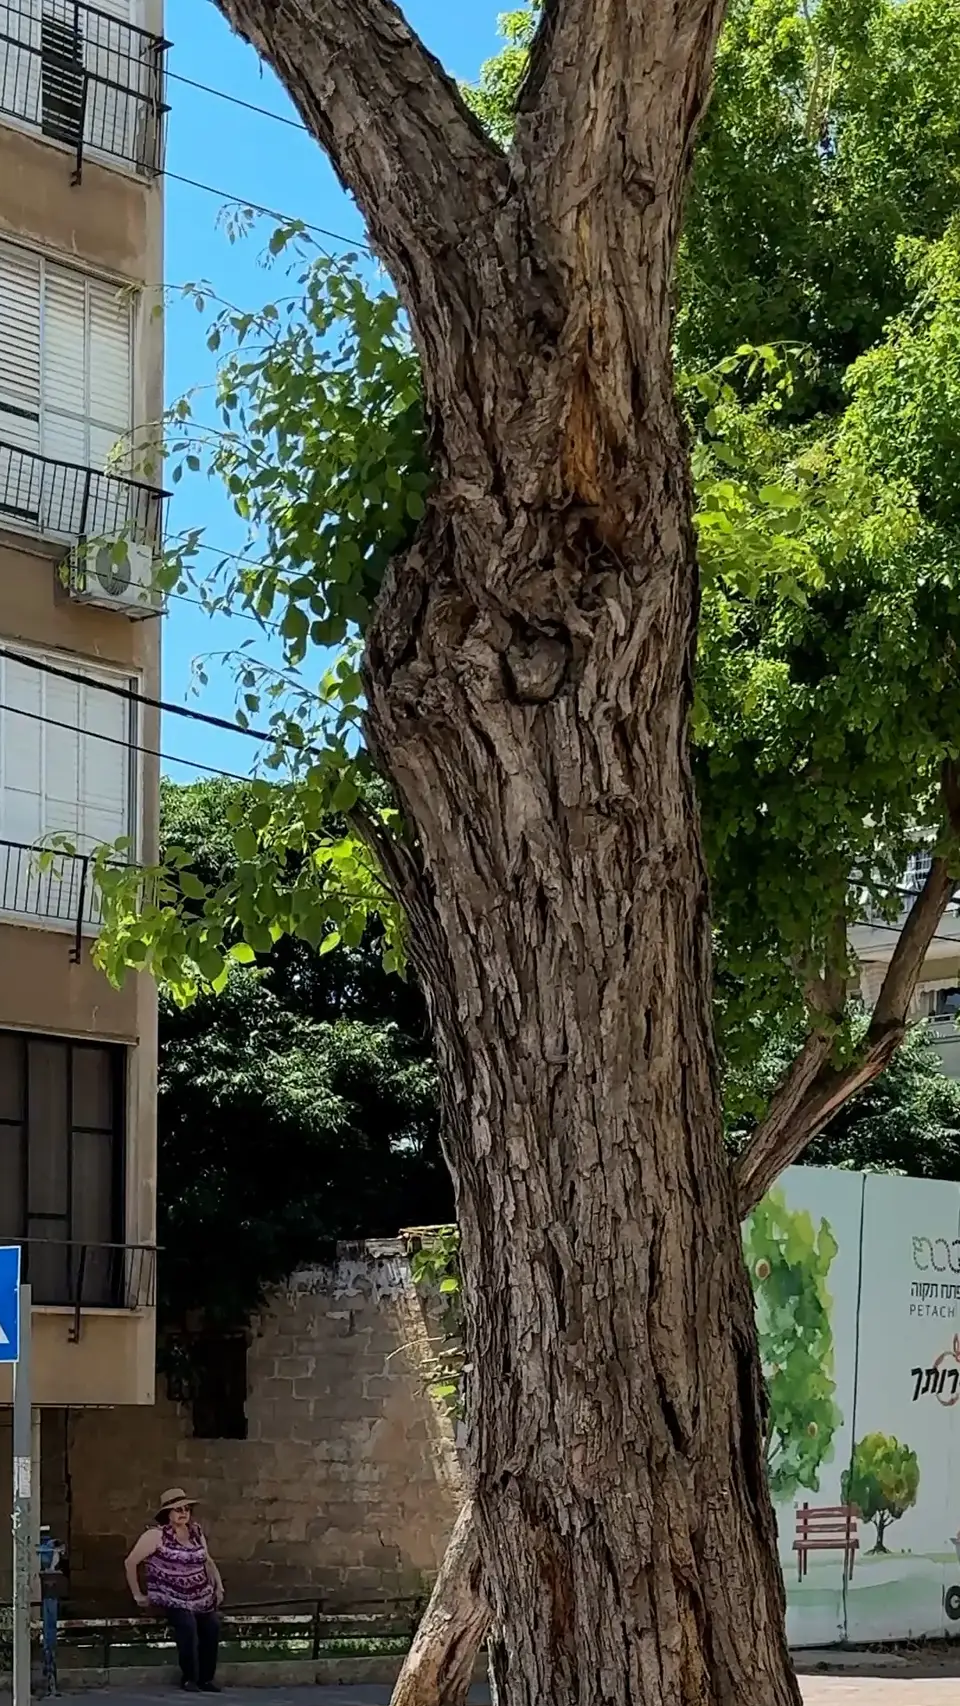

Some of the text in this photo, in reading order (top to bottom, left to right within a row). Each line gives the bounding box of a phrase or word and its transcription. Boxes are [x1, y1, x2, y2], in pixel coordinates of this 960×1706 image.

[911, 1282, 938, 1301] תקוה
[909, 1304, 955, 1318] PETACH
[911, 1367, 960, 1402] רותך
